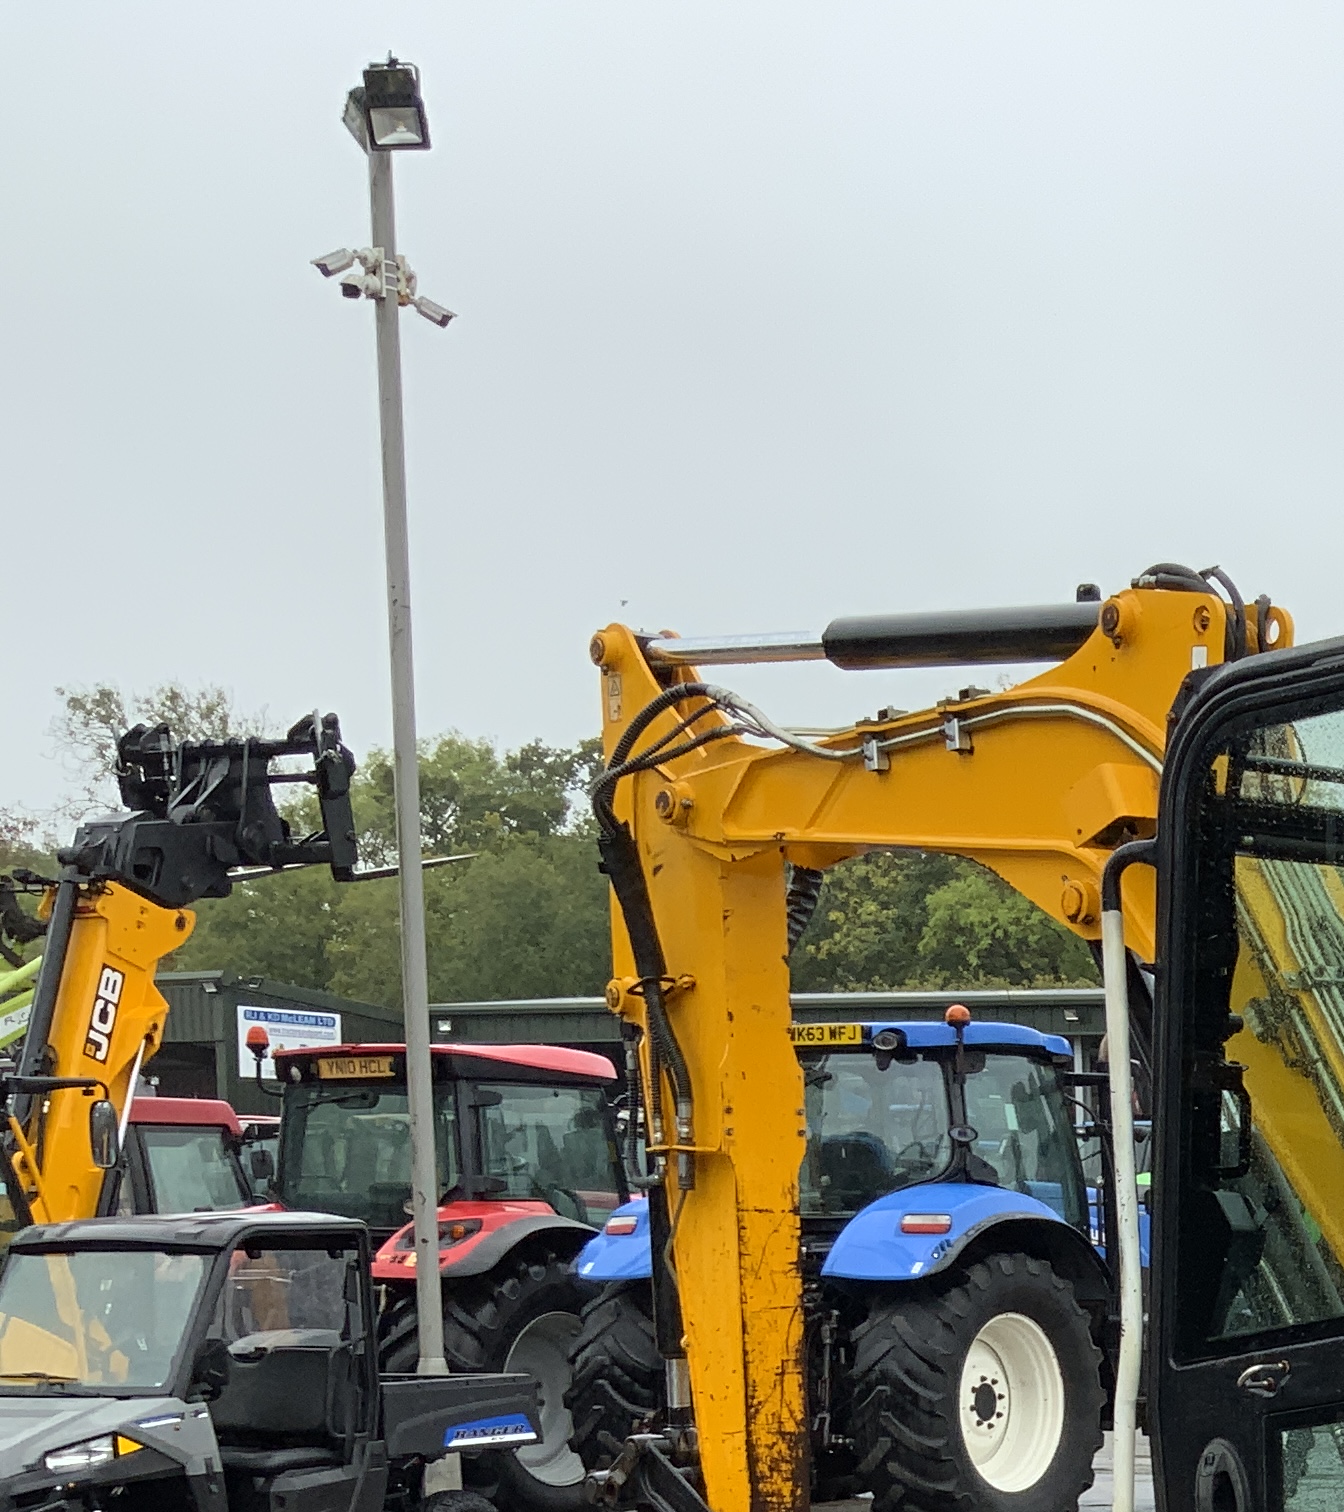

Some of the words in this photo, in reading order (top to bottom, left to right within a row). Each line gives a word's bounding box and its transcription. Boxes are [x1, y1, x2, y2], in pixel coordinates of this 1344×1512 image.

[88, 967, 123, 1061] JCB
[359, 1059, 386, 1074] HCL
[453, 1424, 526, 1440] RANGER
